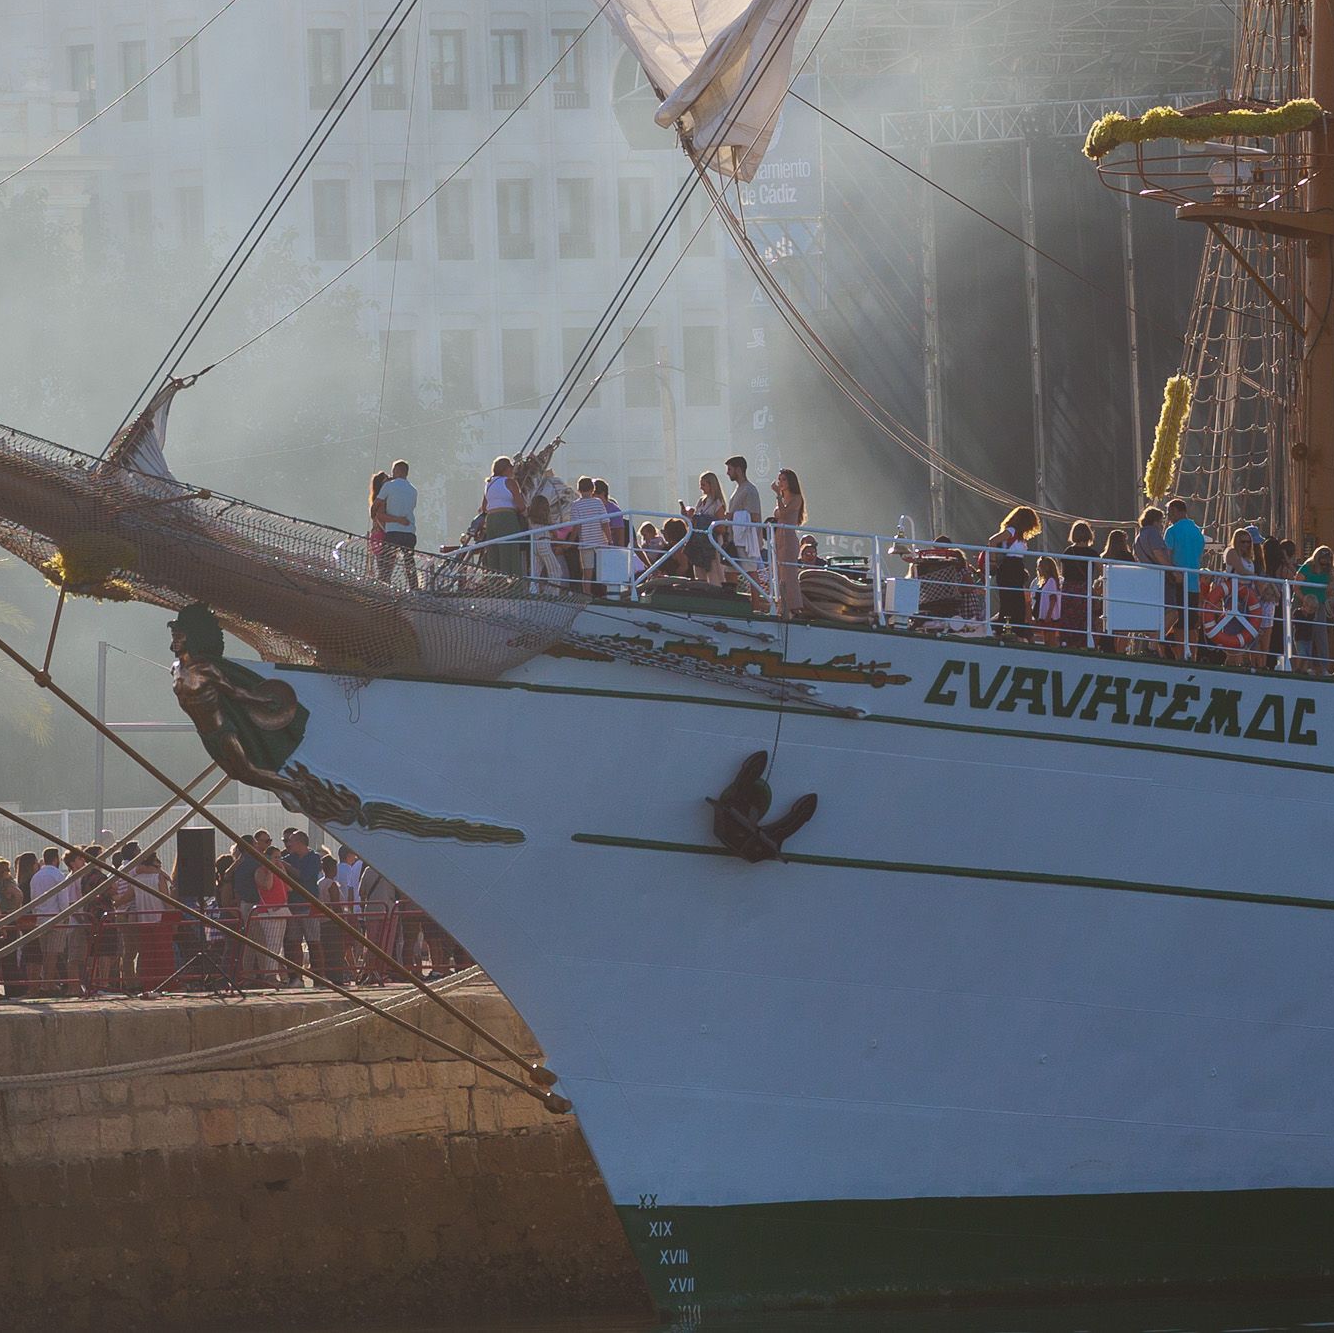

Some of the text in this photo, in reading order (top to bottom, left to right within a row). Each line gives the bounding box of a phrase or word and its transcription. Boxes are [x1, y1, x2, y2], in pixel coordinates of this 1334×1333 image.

[740, 182, 797, 206] de Cádiz
[638, 1193, 658, 1210] XX
[649, 1221, 673, 1238] XIX
[660, 1249, 689, 1265] XVIII
[669, 1277, 695, 1293] XVII
